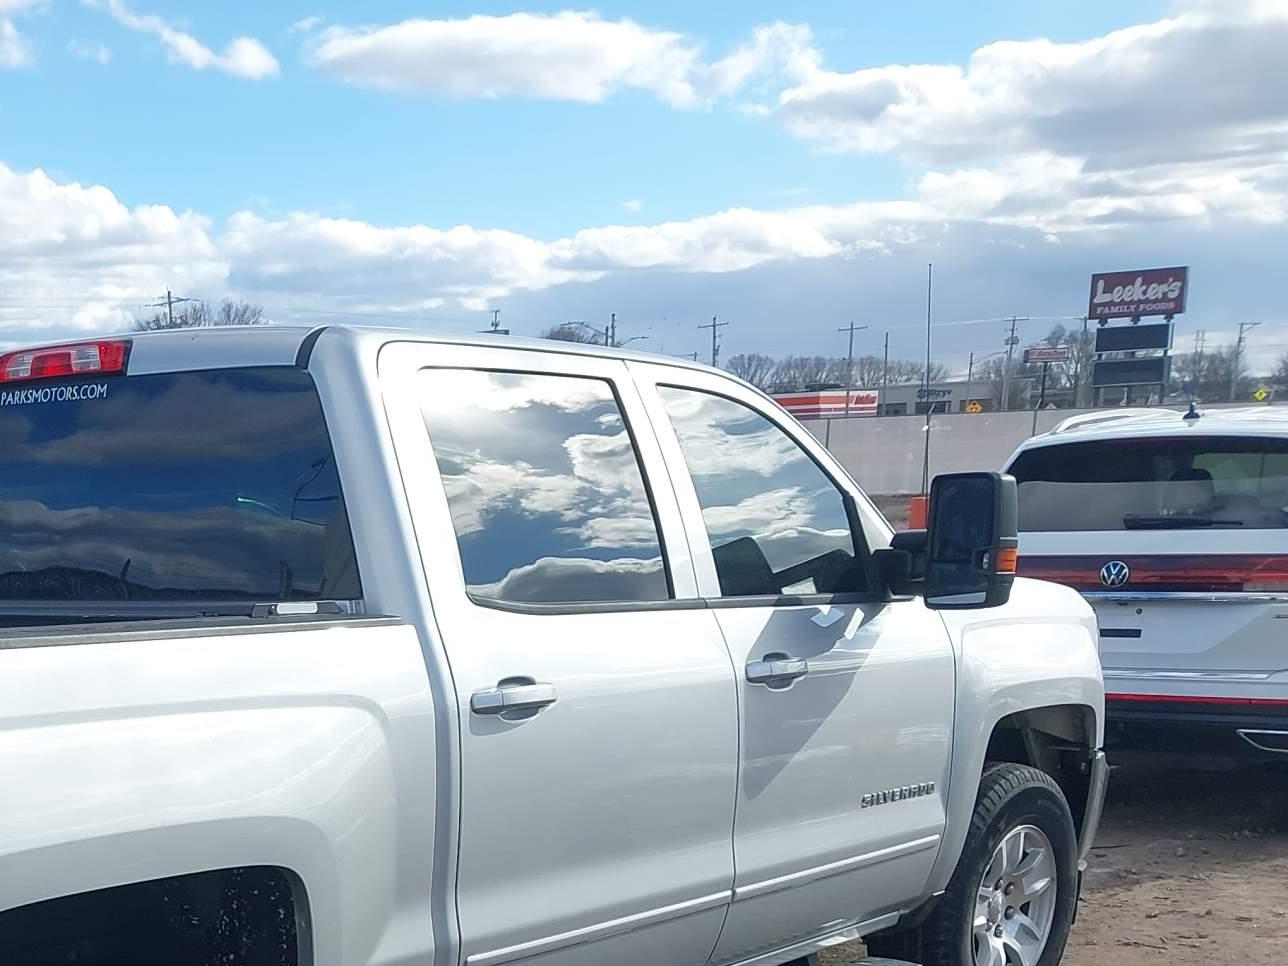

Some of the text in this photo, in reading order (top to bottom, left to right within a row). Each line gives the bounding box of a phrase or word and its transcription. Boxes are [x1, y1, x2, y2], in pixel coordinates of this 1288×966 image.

[1093, 277, 1182, 304] Leeker's
[1096, 301, 1175, 314] FAMILY FOODS
[0, 383, 108, 406] PARKSMOTORS.COM
[860, 781, 936, 809] SILVERADO
